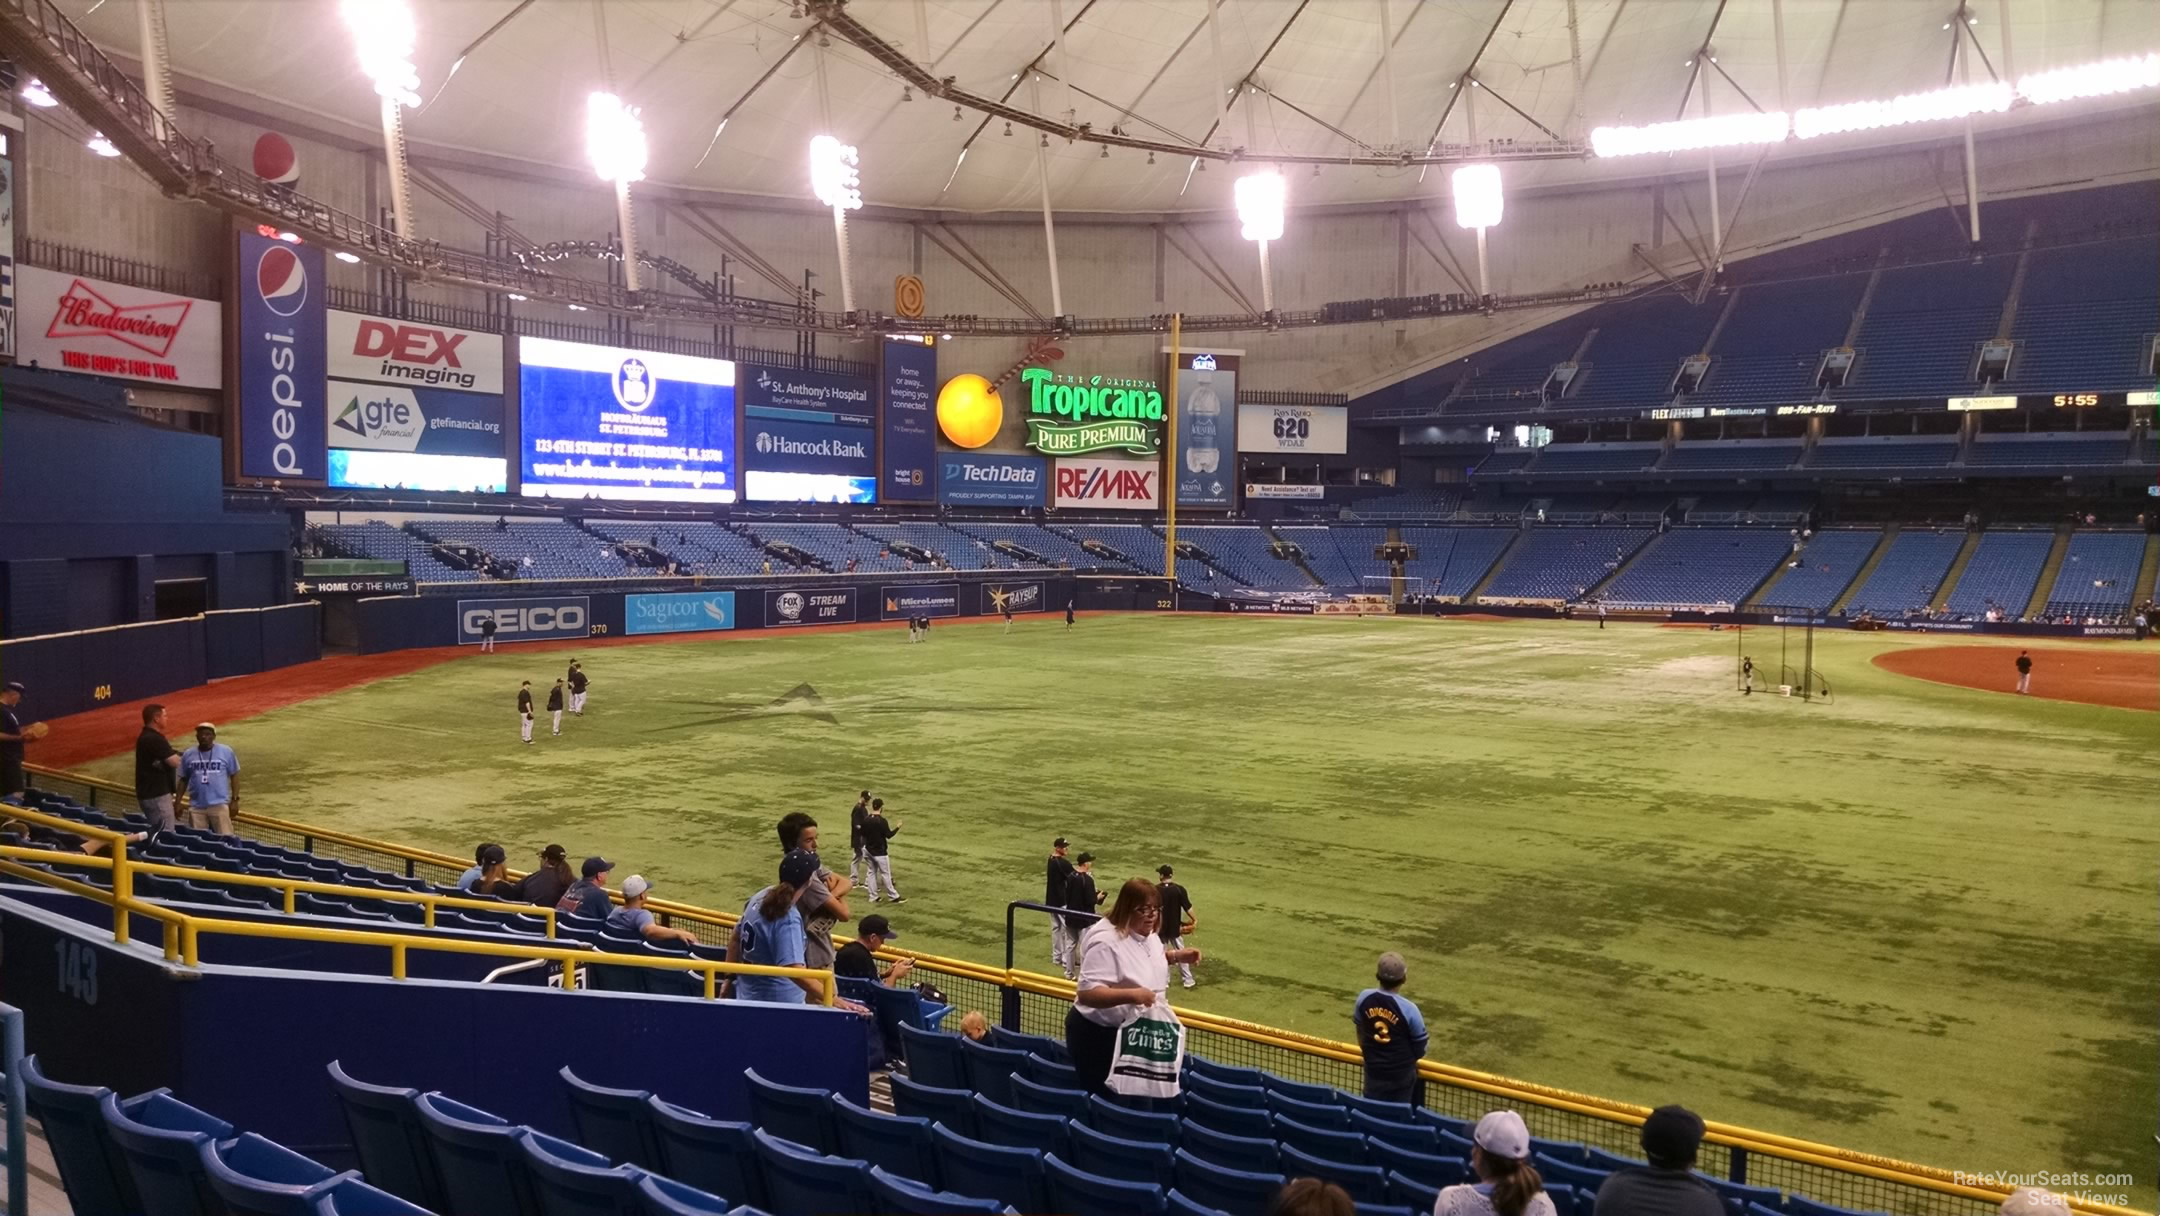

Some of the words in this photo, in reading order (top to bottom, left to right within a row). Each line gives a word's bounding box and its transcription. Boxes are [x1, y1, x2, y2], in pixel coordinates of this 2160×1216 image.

[59, 296, 178, 338] Budweiser
[353, 320, 468, 368] DEX
[61, 351, 89, 368] THIS
[92, 354, 127, 373] BUD'S
[129, 359, 151, 376] FOR
[900, 366, 919, 376] home
[381, 360, 475, 388] imaging
[1057, 375, 1083, 384] THE
[1107, 377, 1157, 388] ORIGINAL
[772, 381, 785, 393] St.
[786, 383, 831, 399] Anthony's
[832, 388, 867, 402] Hospital
[891, 386, 916, 399] keeping
[917, 392, 929, 400] you
[1021, 368, 1162, 421] Tropicana
[265, 332, 303, 475] pepsi
[2054, 395, 2098, 407] 5:55
[366, 397, 410, 430] gte
[1652, 409, 1669, 419] FLEX
[374, 426, 415, 439] financial
[430, 418, 500, 434] gtefinancial.org
[1273, 417, 1309, 439] 620
[773, 435, 832, 456] Hancock
[833, 440, 866, 458] Bank
[1038, 429, 1078, 449] PURE
[1080, 426, 1146, 448] PREMIUM
[575, 441, 612, 456] STREET
[895, 469, 910, 477] bright
[963, 464, 1000, 481] Tech
[1000, 466, 1035, 482] Data
[1057, 467, 1153, 499] RE/MAX
[318, 583, 349, 592] HOME
[350, 582, 364, 591] OF
[365, 582, 382, 591] THE
[384, 582, 409, 591] RAYS
[783, 596, 798, 606] FOX
[810, 595, 847, 605] STREAM
[901, 597, 955, 605] MicroLumen
[1157, 600, 1172, 608] 322
[636, 597, 700, 623] Sagicor
[819, 607, 837, 617] LIVE
[464, 606, 584, 634] GEICO
[591, 624, 607, 634] 370
[94, 685, 111, 699] 404
[56, 937, 97, 1005] 143
[1127, 1027, 1174, 1051] Times
[1373, 1021, 1391, 1043] 3
